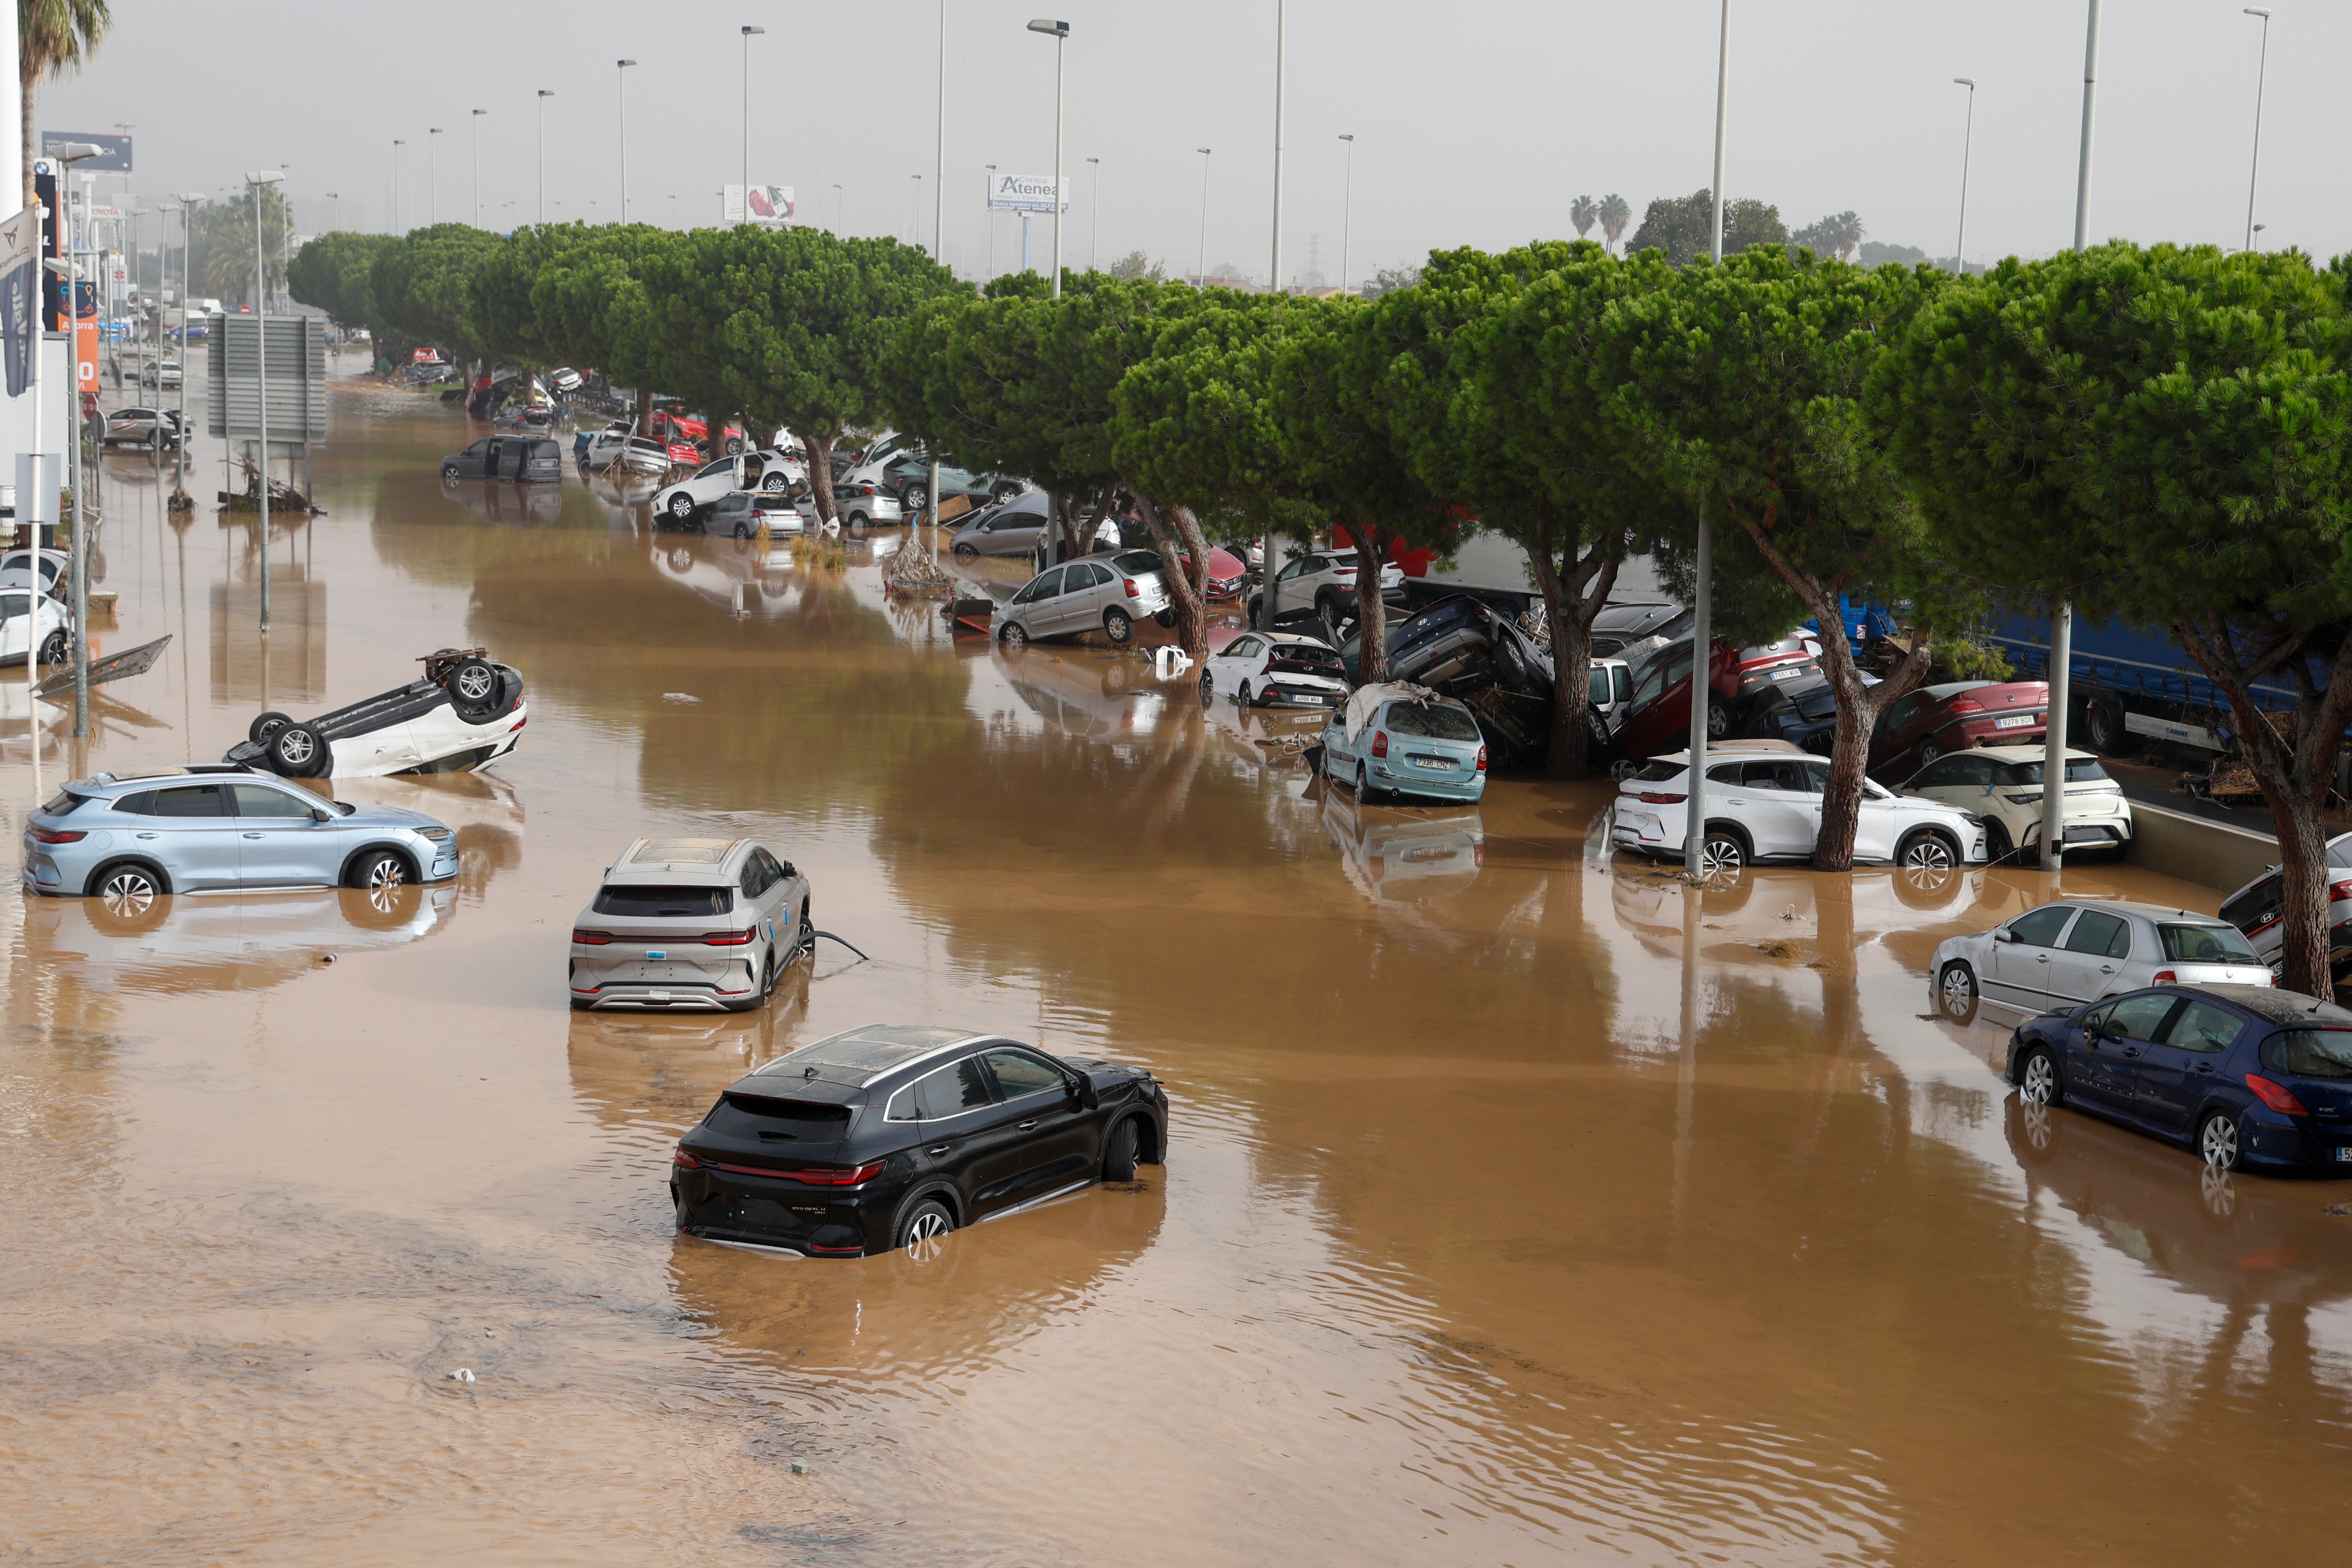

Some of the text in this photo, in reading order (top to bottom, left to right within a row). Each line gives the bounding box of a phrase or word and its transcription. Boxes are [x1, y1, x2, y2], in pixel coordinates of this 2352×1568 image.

[62, 321, 94, 330] Aorra
[1408, 618, 1441, 637] KONA
[2002, 716, 2033, 726] 9278 BDR
[2170, 729, 2188, 737] KRONE
[1437, 760, 1448, 768] CHZ
